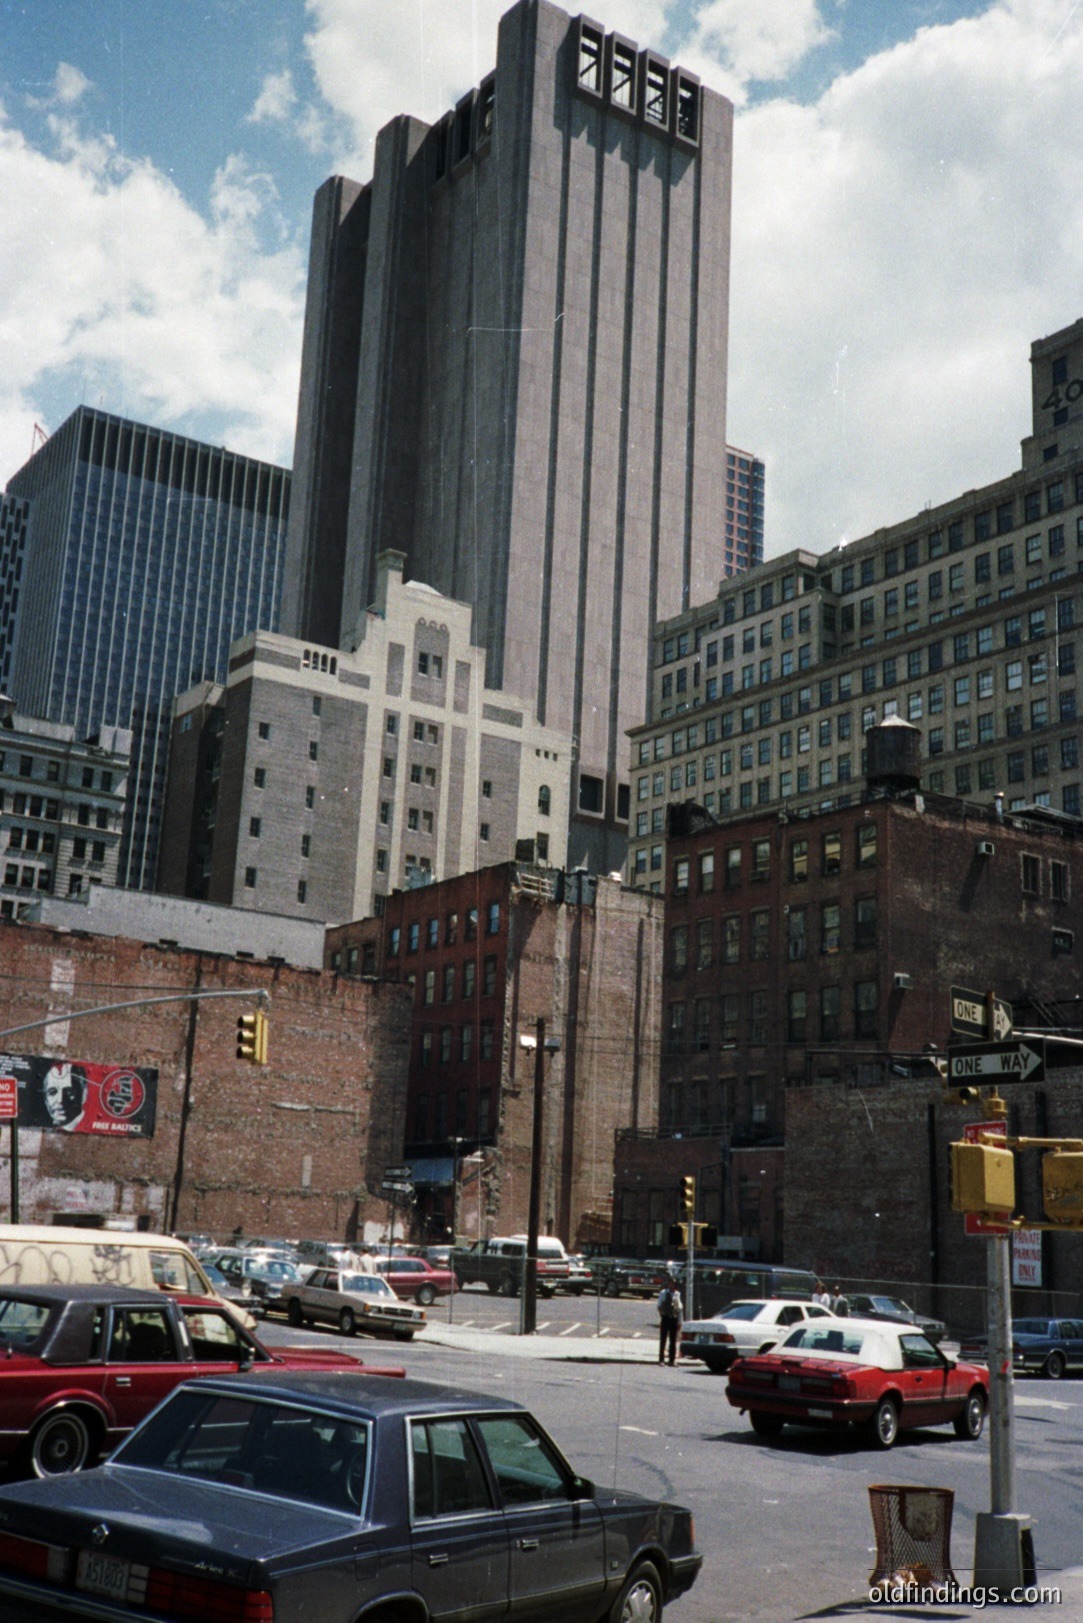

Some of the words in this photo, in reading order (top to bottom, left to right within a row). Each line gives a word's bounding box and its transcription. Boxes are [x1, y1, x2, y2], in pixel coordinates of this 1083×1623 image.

[957, 1001, 978, 1022] ONE
[956, 1057, 983, 1075] ONE
[1000, 1053, 1031, 1071] WAY
[92, 1121, 110, 1131] FREE
[111, 1122, 142, 1133] BALTICS
[1014, 1230, 1040, 1245] PRIVATE
[1013, 1247, 1041, 1261] PARKING
[1018, 1263, 1036, 1278] ONLY
